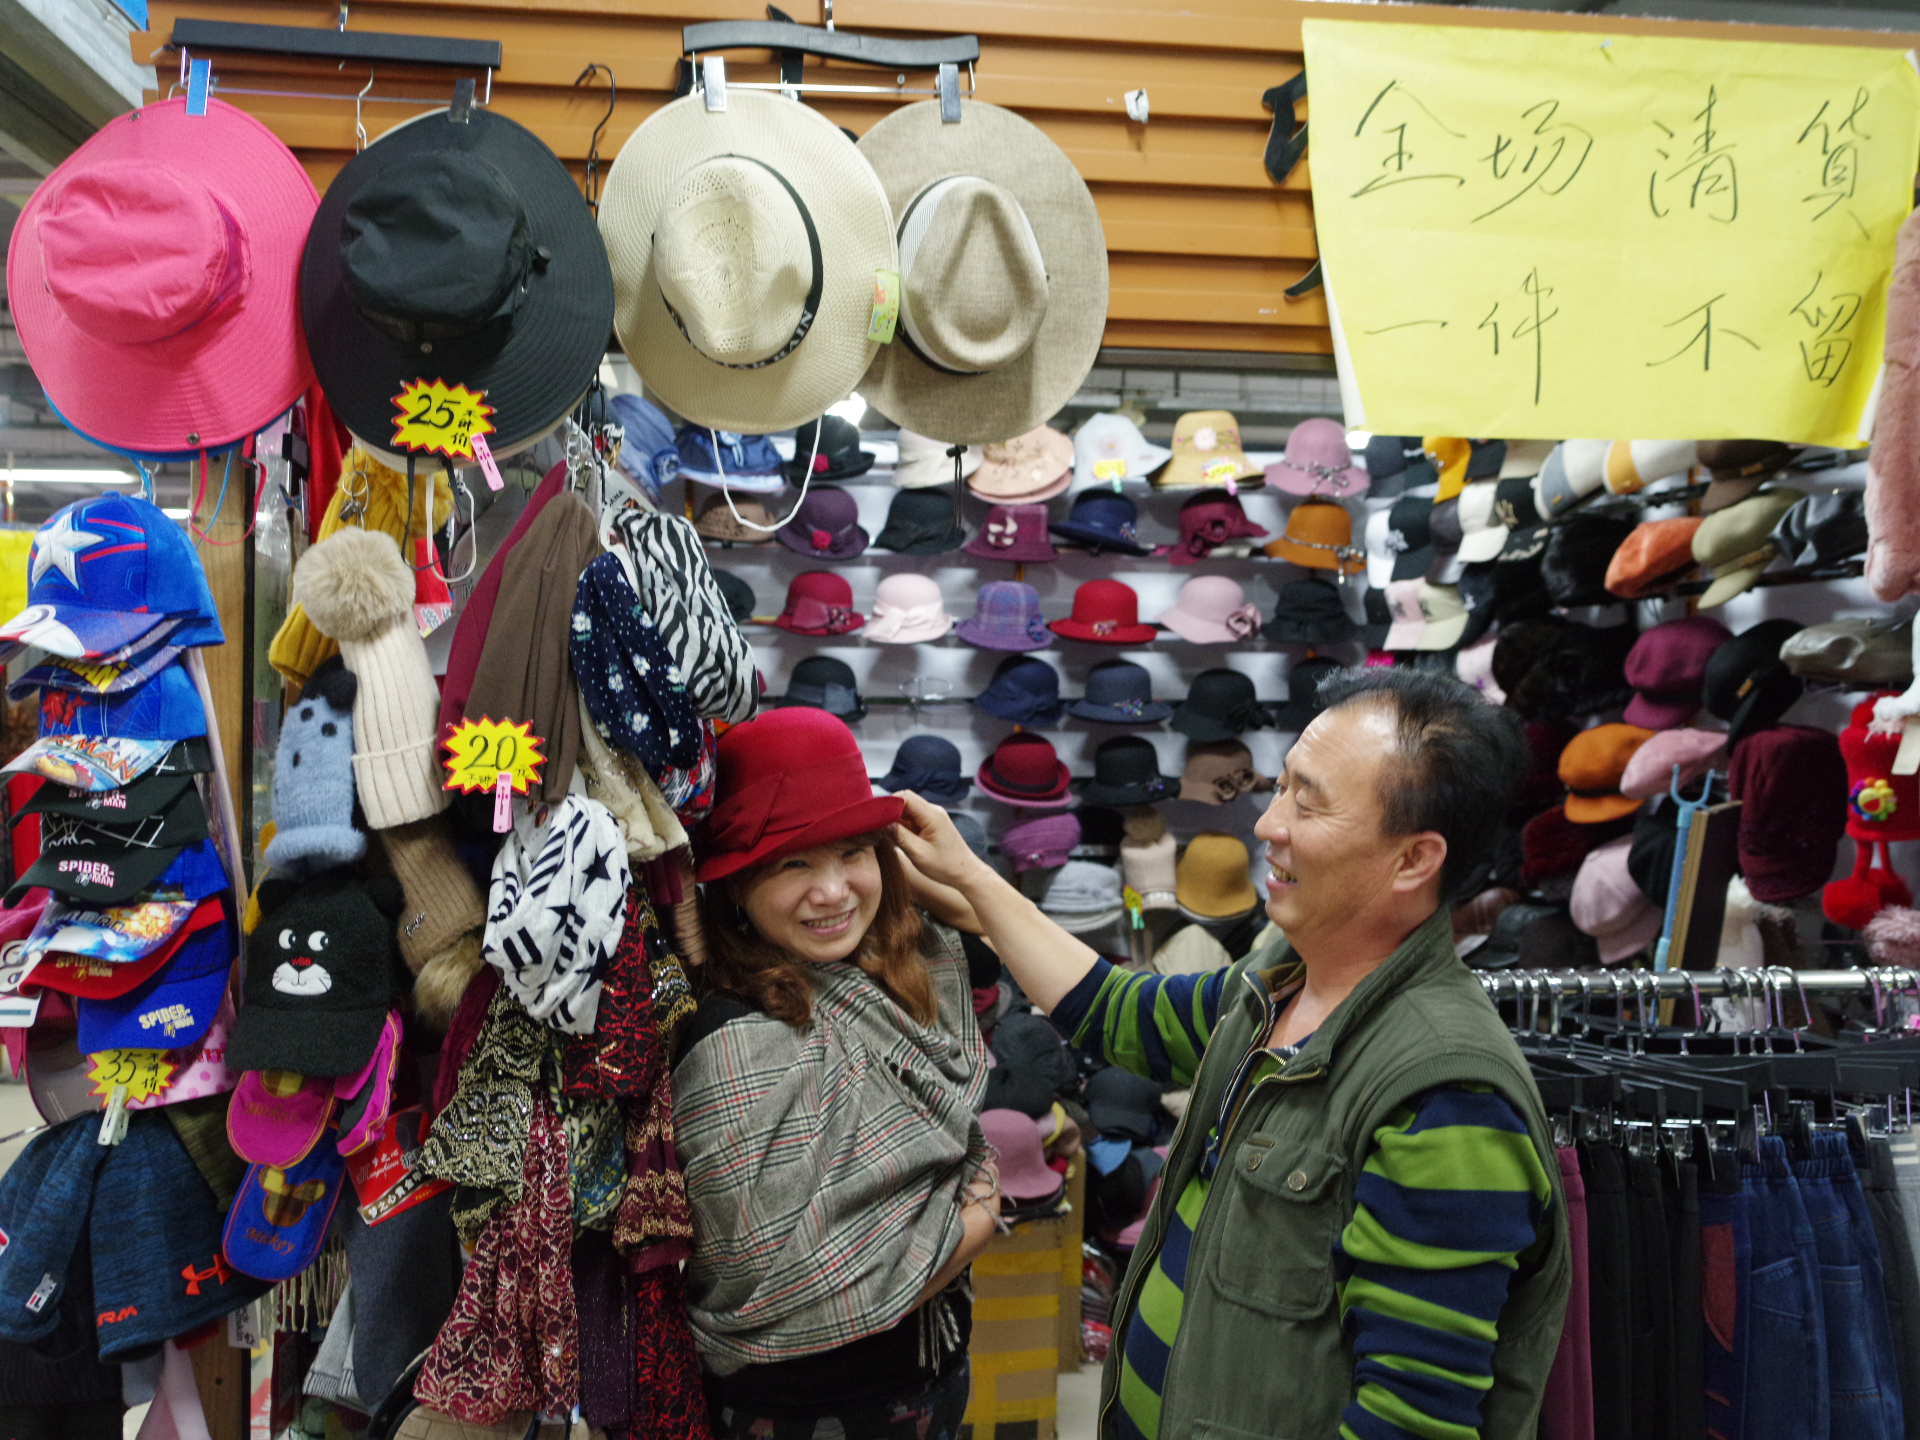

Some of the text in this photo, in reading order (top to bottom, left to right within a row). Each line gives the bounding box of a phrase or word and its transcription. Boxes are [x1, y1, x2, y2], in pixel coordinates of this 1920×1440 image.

[1364, 266, 1864, 406] 一件不留
[408, 394, 461, 429] 25
[464, 735, 517, 770] 20
[58, 860, 115, 877] SPIDER-
[102, 1050, 141, 1084] 35
